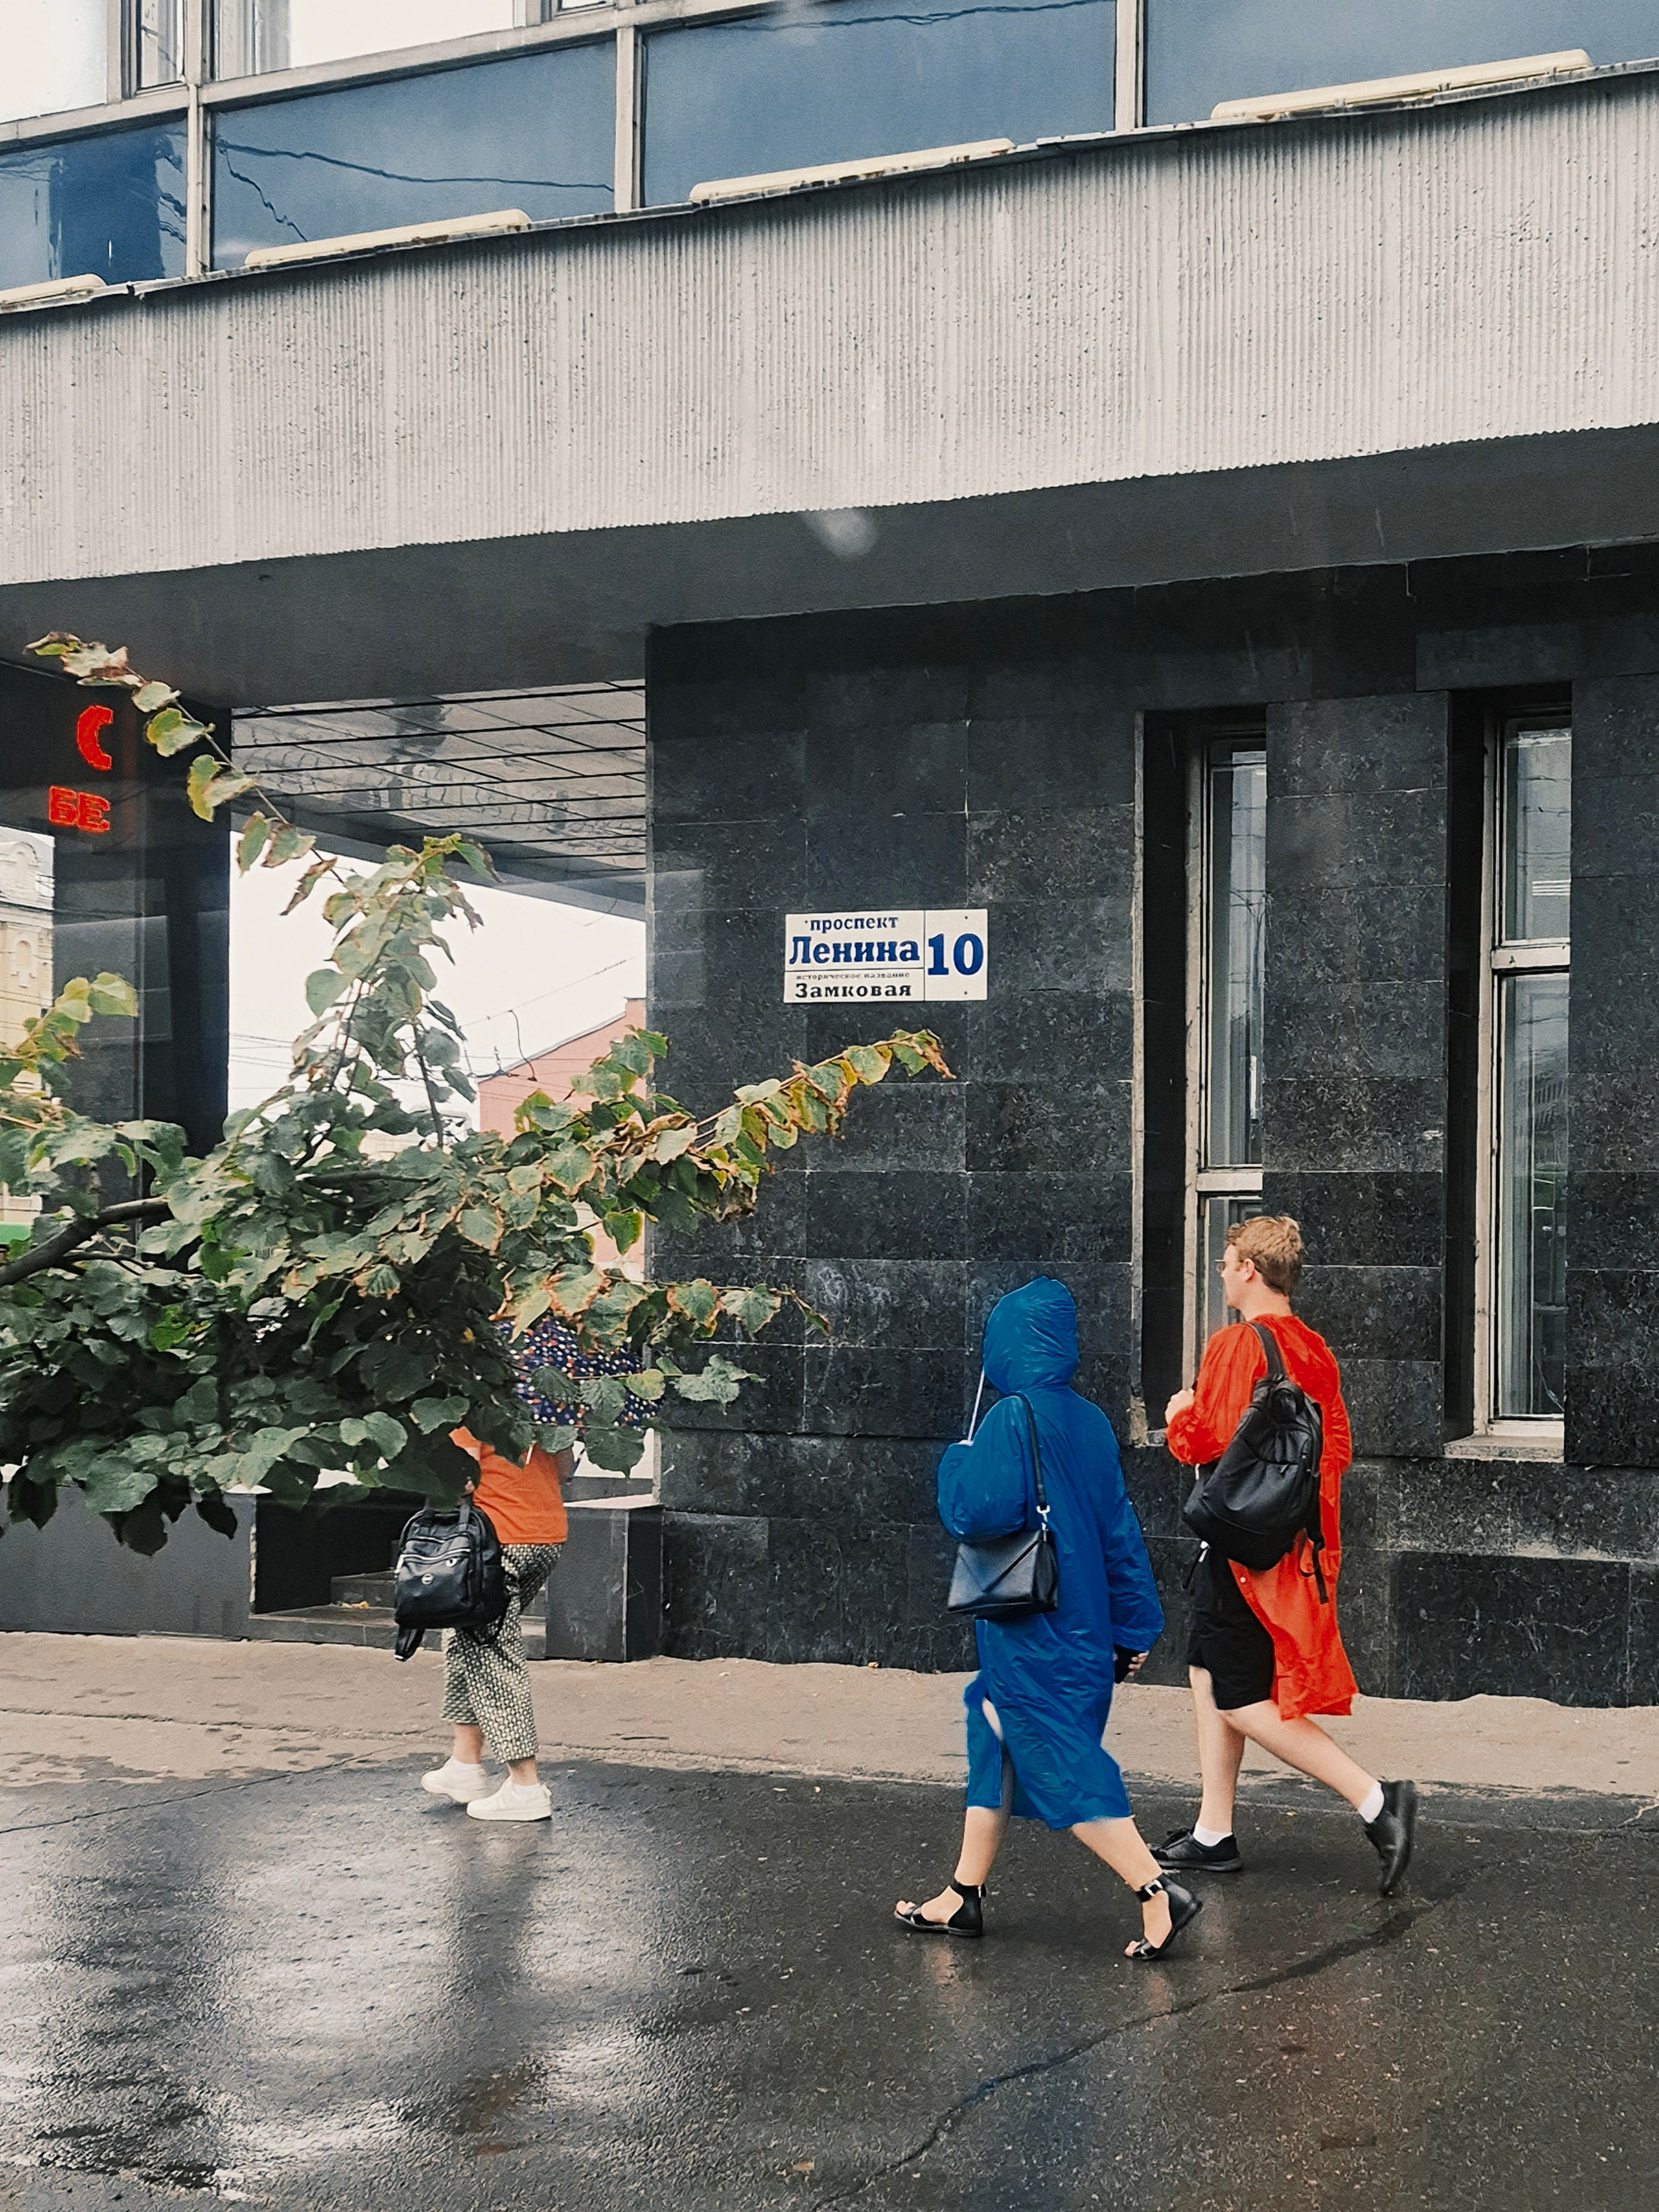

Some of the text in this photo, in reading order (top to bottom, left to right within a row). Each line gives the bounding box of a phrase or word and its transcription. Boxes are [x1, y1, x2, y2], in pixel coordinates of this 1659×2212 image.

[809, 917, 899, 934] проспект
[789, 936, 920, 965] Ленина
[927, 933, 984, 976] 10
[795, 982, 912, 999] Замковая
